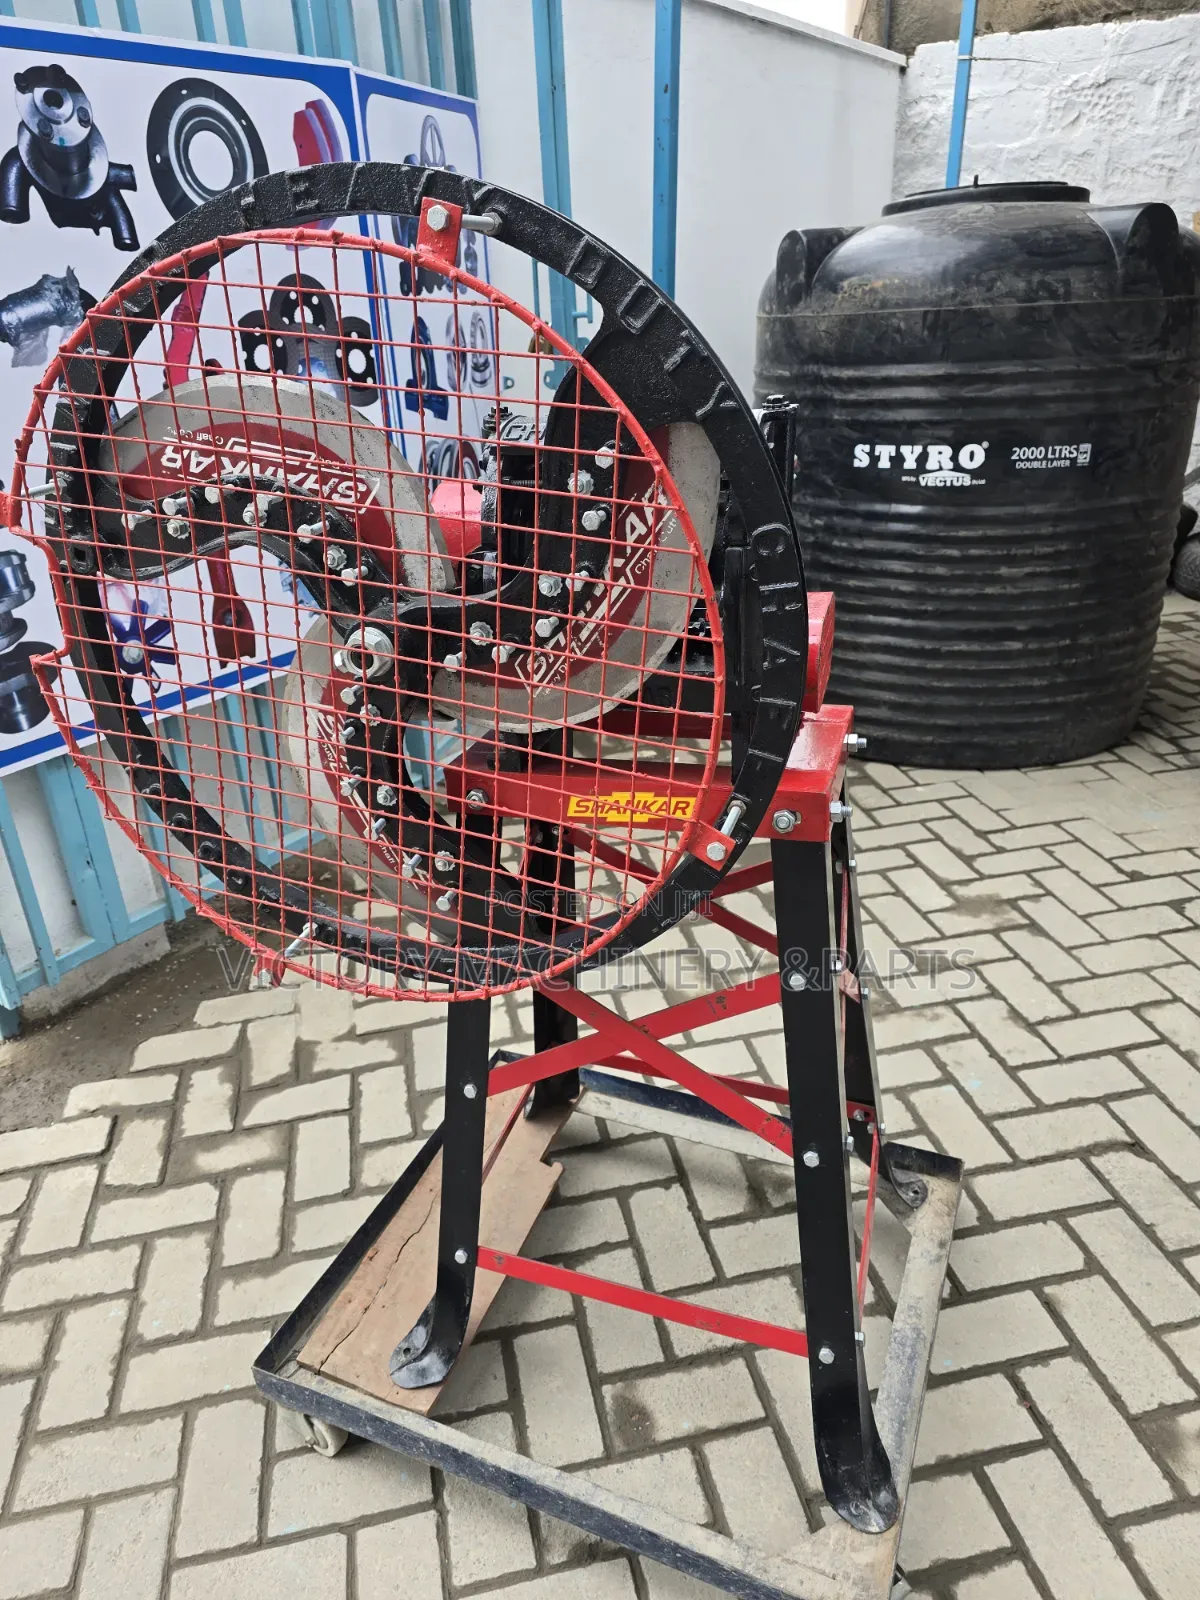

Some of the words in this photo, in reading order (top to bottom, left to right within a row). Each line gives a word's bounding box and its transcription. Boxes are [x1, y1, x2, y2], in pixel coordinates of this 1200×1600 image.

[853, 443, 986, 470] STYRO
[1011, 446, 1045, 460] 2000
[1047, 444, 1078, 460] LTRS
[1015, 460, 1047, 469] DOUBLE
[1047, 459, 1071, 468] LAYER
[919, 475, 971, 487] VECTUS
[573, 798, 692, 817] SHANKAR
